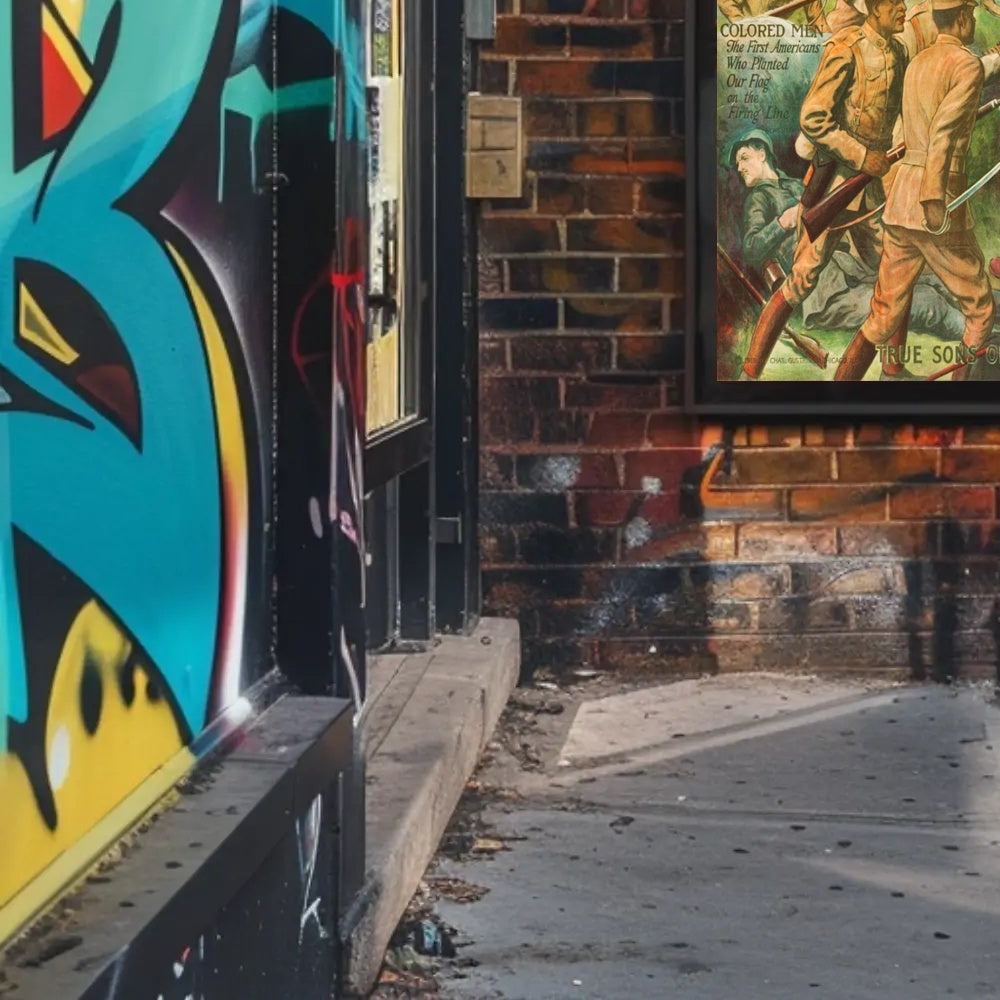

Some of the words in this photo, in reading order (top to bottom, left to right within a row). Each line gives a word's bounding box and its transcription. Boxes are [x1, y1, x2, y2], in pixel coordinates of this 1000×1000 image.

[720, 23, 786, 38] COLORED
[791, 23, 824, 38] MEN
[726, 39, 744, 53] The
[746, 40, 769, 53] First
[770, 39, 821, 54] Americans
[727, 55, 748, 70] Who
[750, 56, 790, 70] Planted
[726, 73, 747, 88] Our
[748, 73, 772, 93] Flag
[727, 93, 739, 104] on
[744, 91, 760, 104] the
[728, 105, 761, 125] Firing
[765, 105, 791, 120] Line
[875, 344, 924, 364] TRUE
[932, 345, 978, 365] SONS
